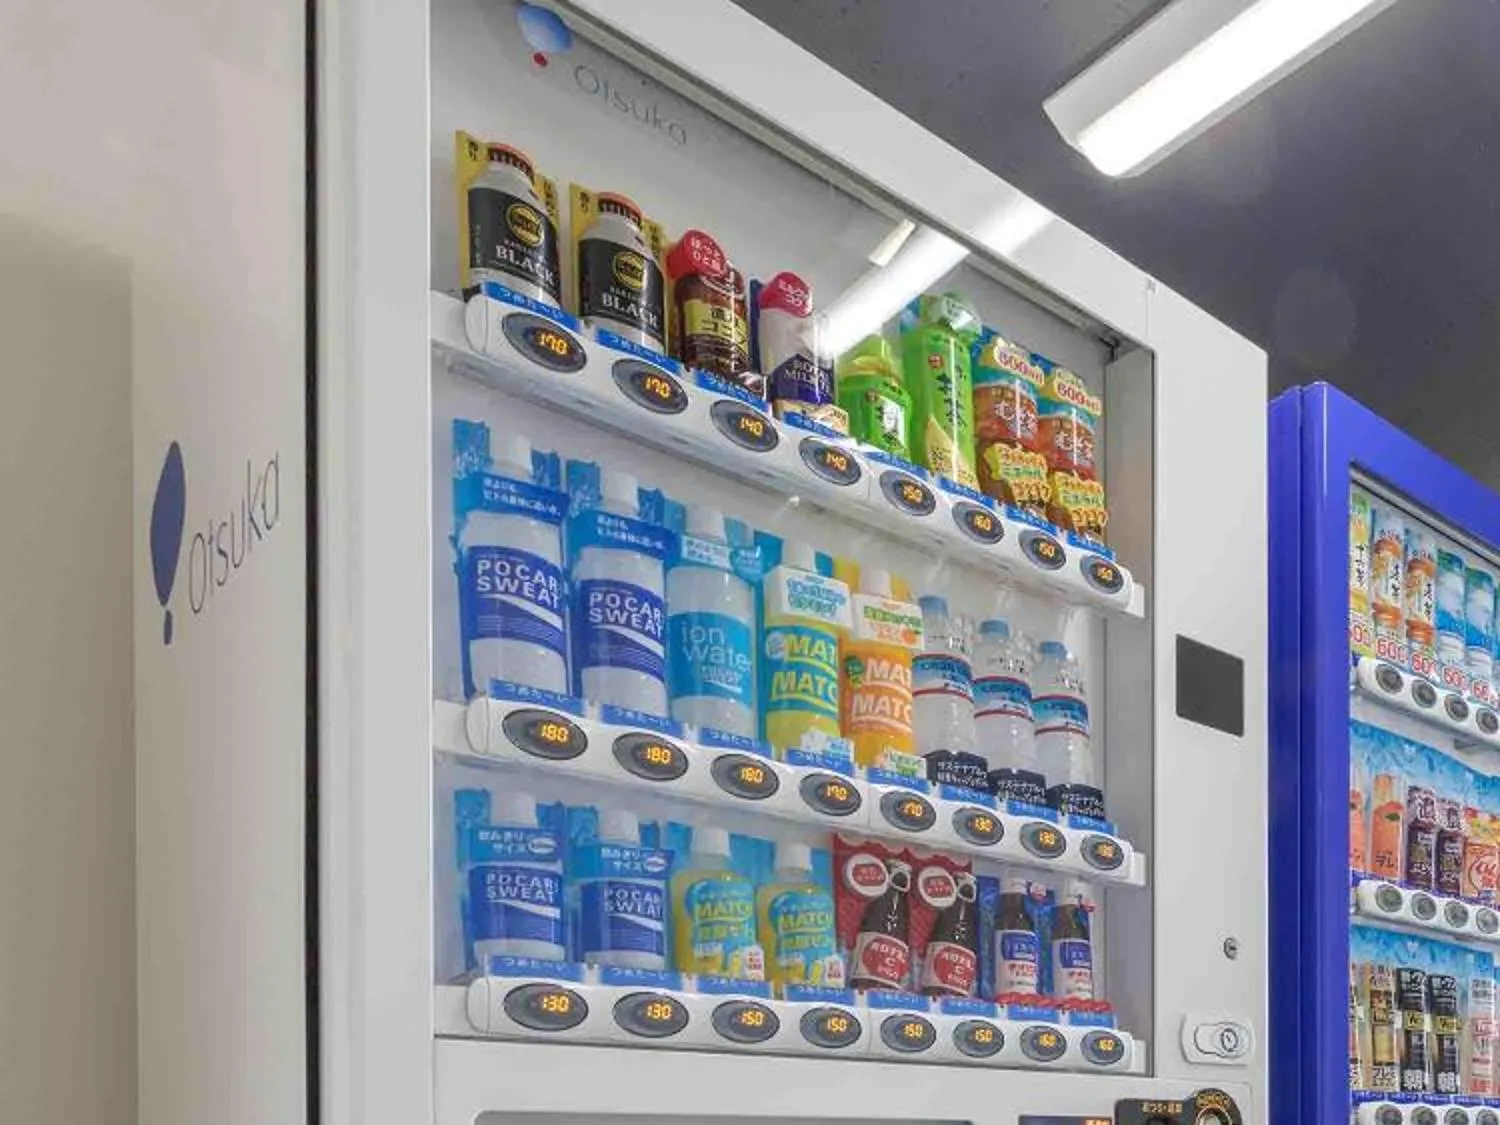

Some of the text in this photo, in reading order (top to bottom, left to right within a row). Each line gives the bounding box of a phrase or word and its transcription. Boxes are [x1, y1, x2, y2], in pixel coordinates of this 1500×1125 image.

[574, 65, 687, 145] Otsuka
[496, 244, 553, 286] BLACK
[603, 292, 659, 328] BLACK
[537, 327, 569, 356] 170
[644, 376, 672, 399] 170
[740, 418, 764, 438] 140
[188, 450, 280, 615] Otsuka
[476, 574, 560, 610] SWEAT
[589, 607, 663, 638] SWEAT
[681, 620, 725, 645] ion
[539, 724, 570, 744] 180
[646, 746, 672, 766] 180
[486, 885, 555, 903] SWEAT
[542, 993, 569, 1013] 130
[647, 1003, 672, 1020] 130
[826, 1018, 847, 1033] 150
